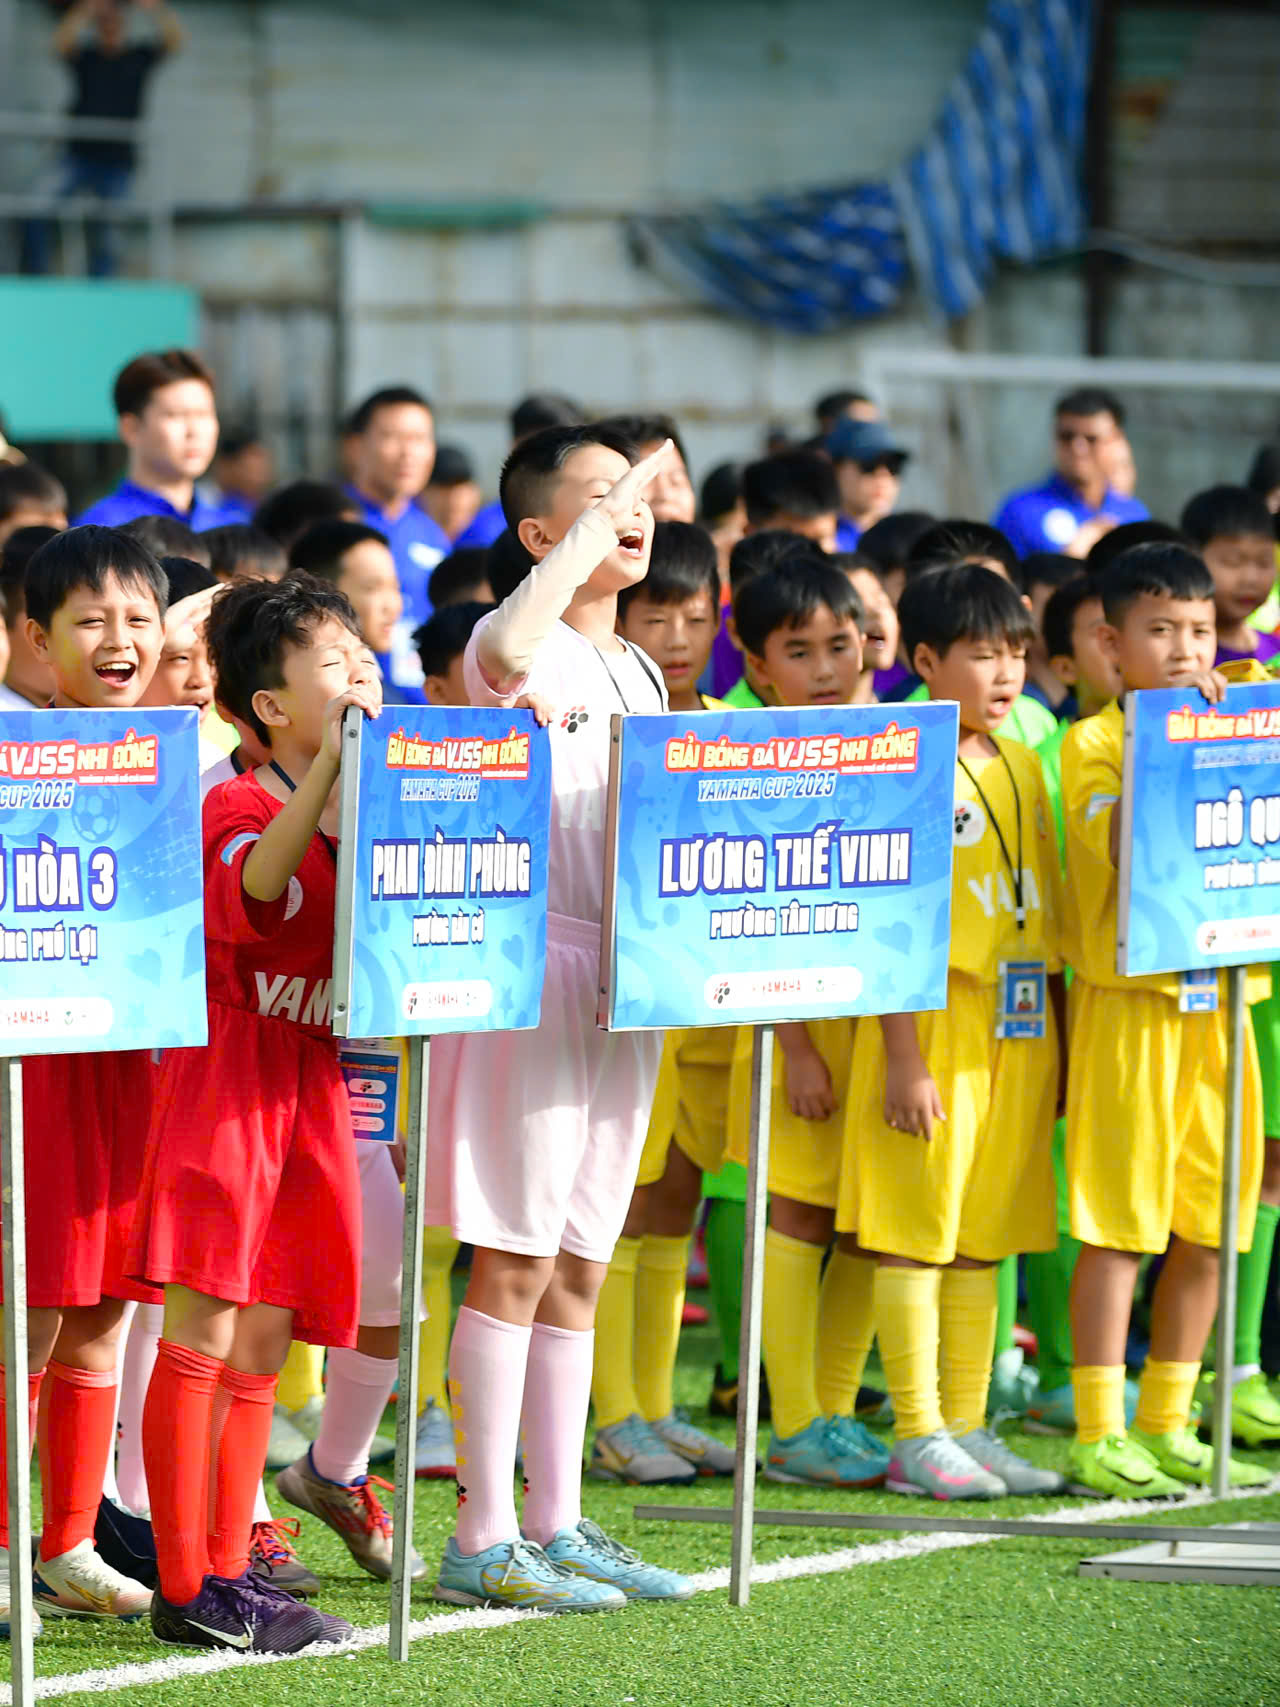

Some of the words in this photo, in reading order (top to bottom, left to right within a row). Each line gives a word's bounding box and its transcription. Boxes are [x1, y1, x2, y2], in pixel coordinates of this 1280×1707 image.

[7, 744, 75, 775] VJSS
[77, 747, 108, 770] NHI
[112, 732, 155, 769] ĐỒNG
[446, 740, 483, 769] VJSS
[668, 733, 699, 768] GIẢI
[703, 739, 748, 768] BÓNG
[752, 741, 775, 766] ĐÁ
[775, 738, 840, 768] VJSS
[840, 740, 868, 762] NHI
[871, 724, 917, 760] ĐỒNG
[31, 780, 75, 808] 2025
[438, 778, 457, 801] CUP
[455, 774, 481, 801] 2025
[698, 779, 760, 801] YAMAHA
[763, 777, 795, 799] CUP
[795, 772, 838, 798] 2025
[1196, 788, 1243, 849] NGÔ
[15, 840, 81, 907] HÒA
[90, 852, 115, 906] 3
[372, 844, 420, 895] PHAN
[423, 831, 466, 893] ĐÌNH
[470, 830, 531, 893] PHÙNG
[661, 838, 765, 892] LƯƠNG
[775, 824, 837, 887] THẾ
[840, 833, 910, 883] VINH
[711, 903, 776, 938] PHƯỜNG
[780, 899, 810, 935] TÂN
[814, 903, 858, 933] HƯNG
[32, 922, 66, 960] PHÚ
[69, 926, 98, 964] LỢI
